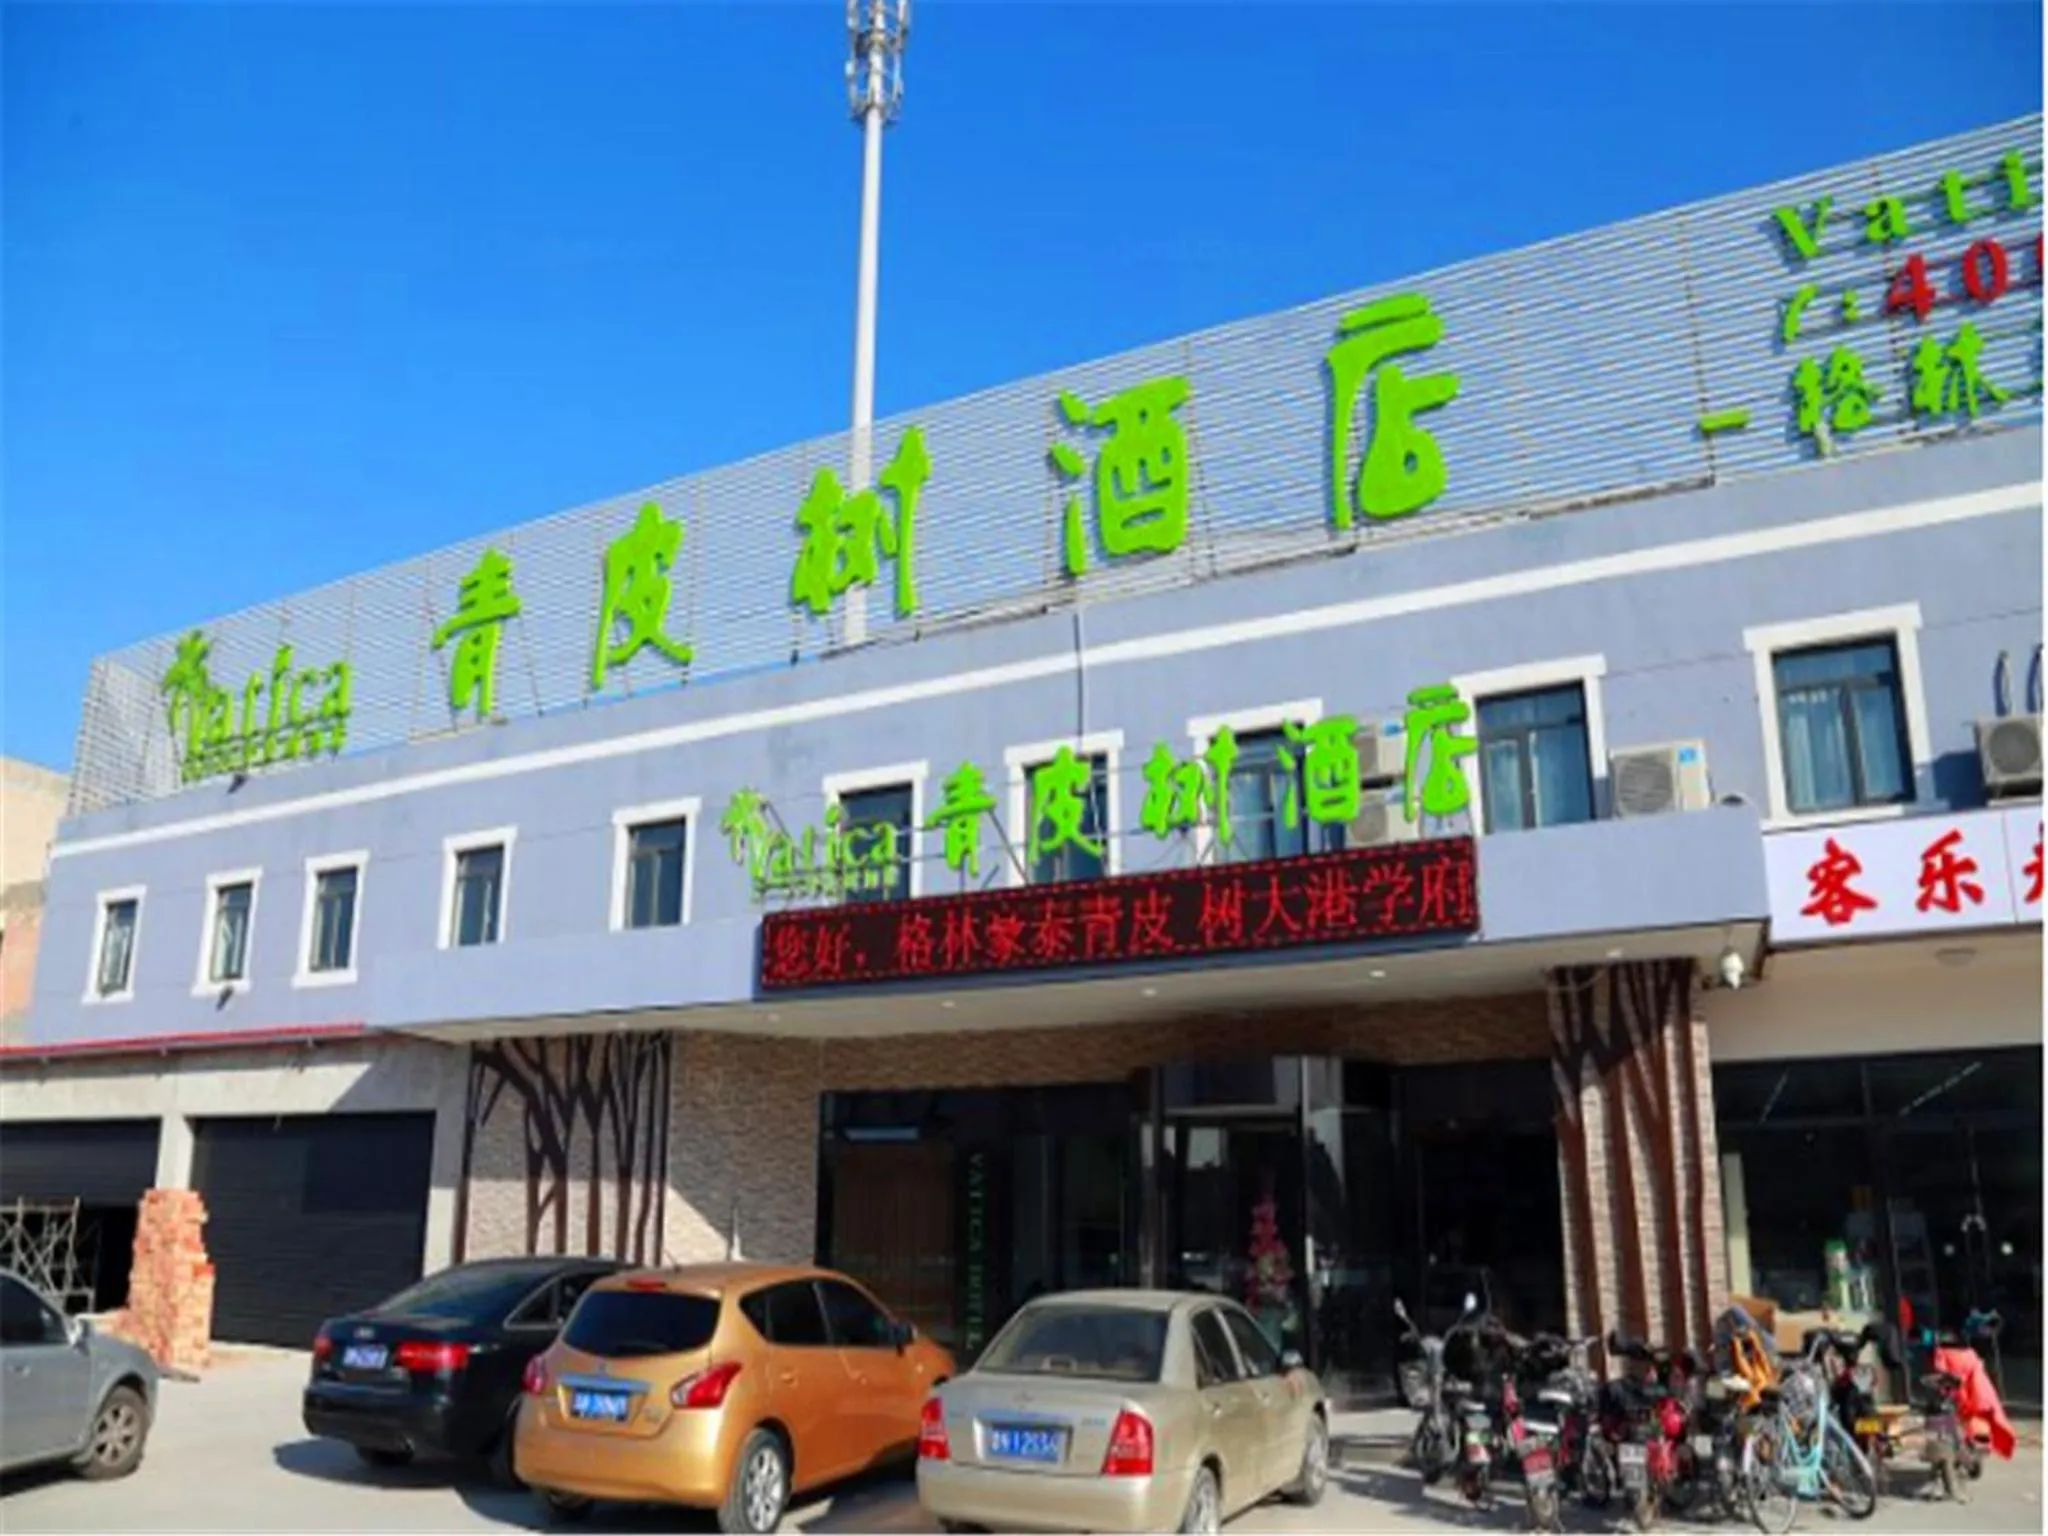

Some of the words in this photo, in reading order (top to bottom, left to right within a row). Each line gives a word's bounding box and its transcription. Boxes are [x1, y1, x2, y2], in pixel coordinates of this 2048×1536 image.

[432, 291, 1460, 715] 青皮树酒店
[924, 684, 1477, 878] 青皮树酒店
